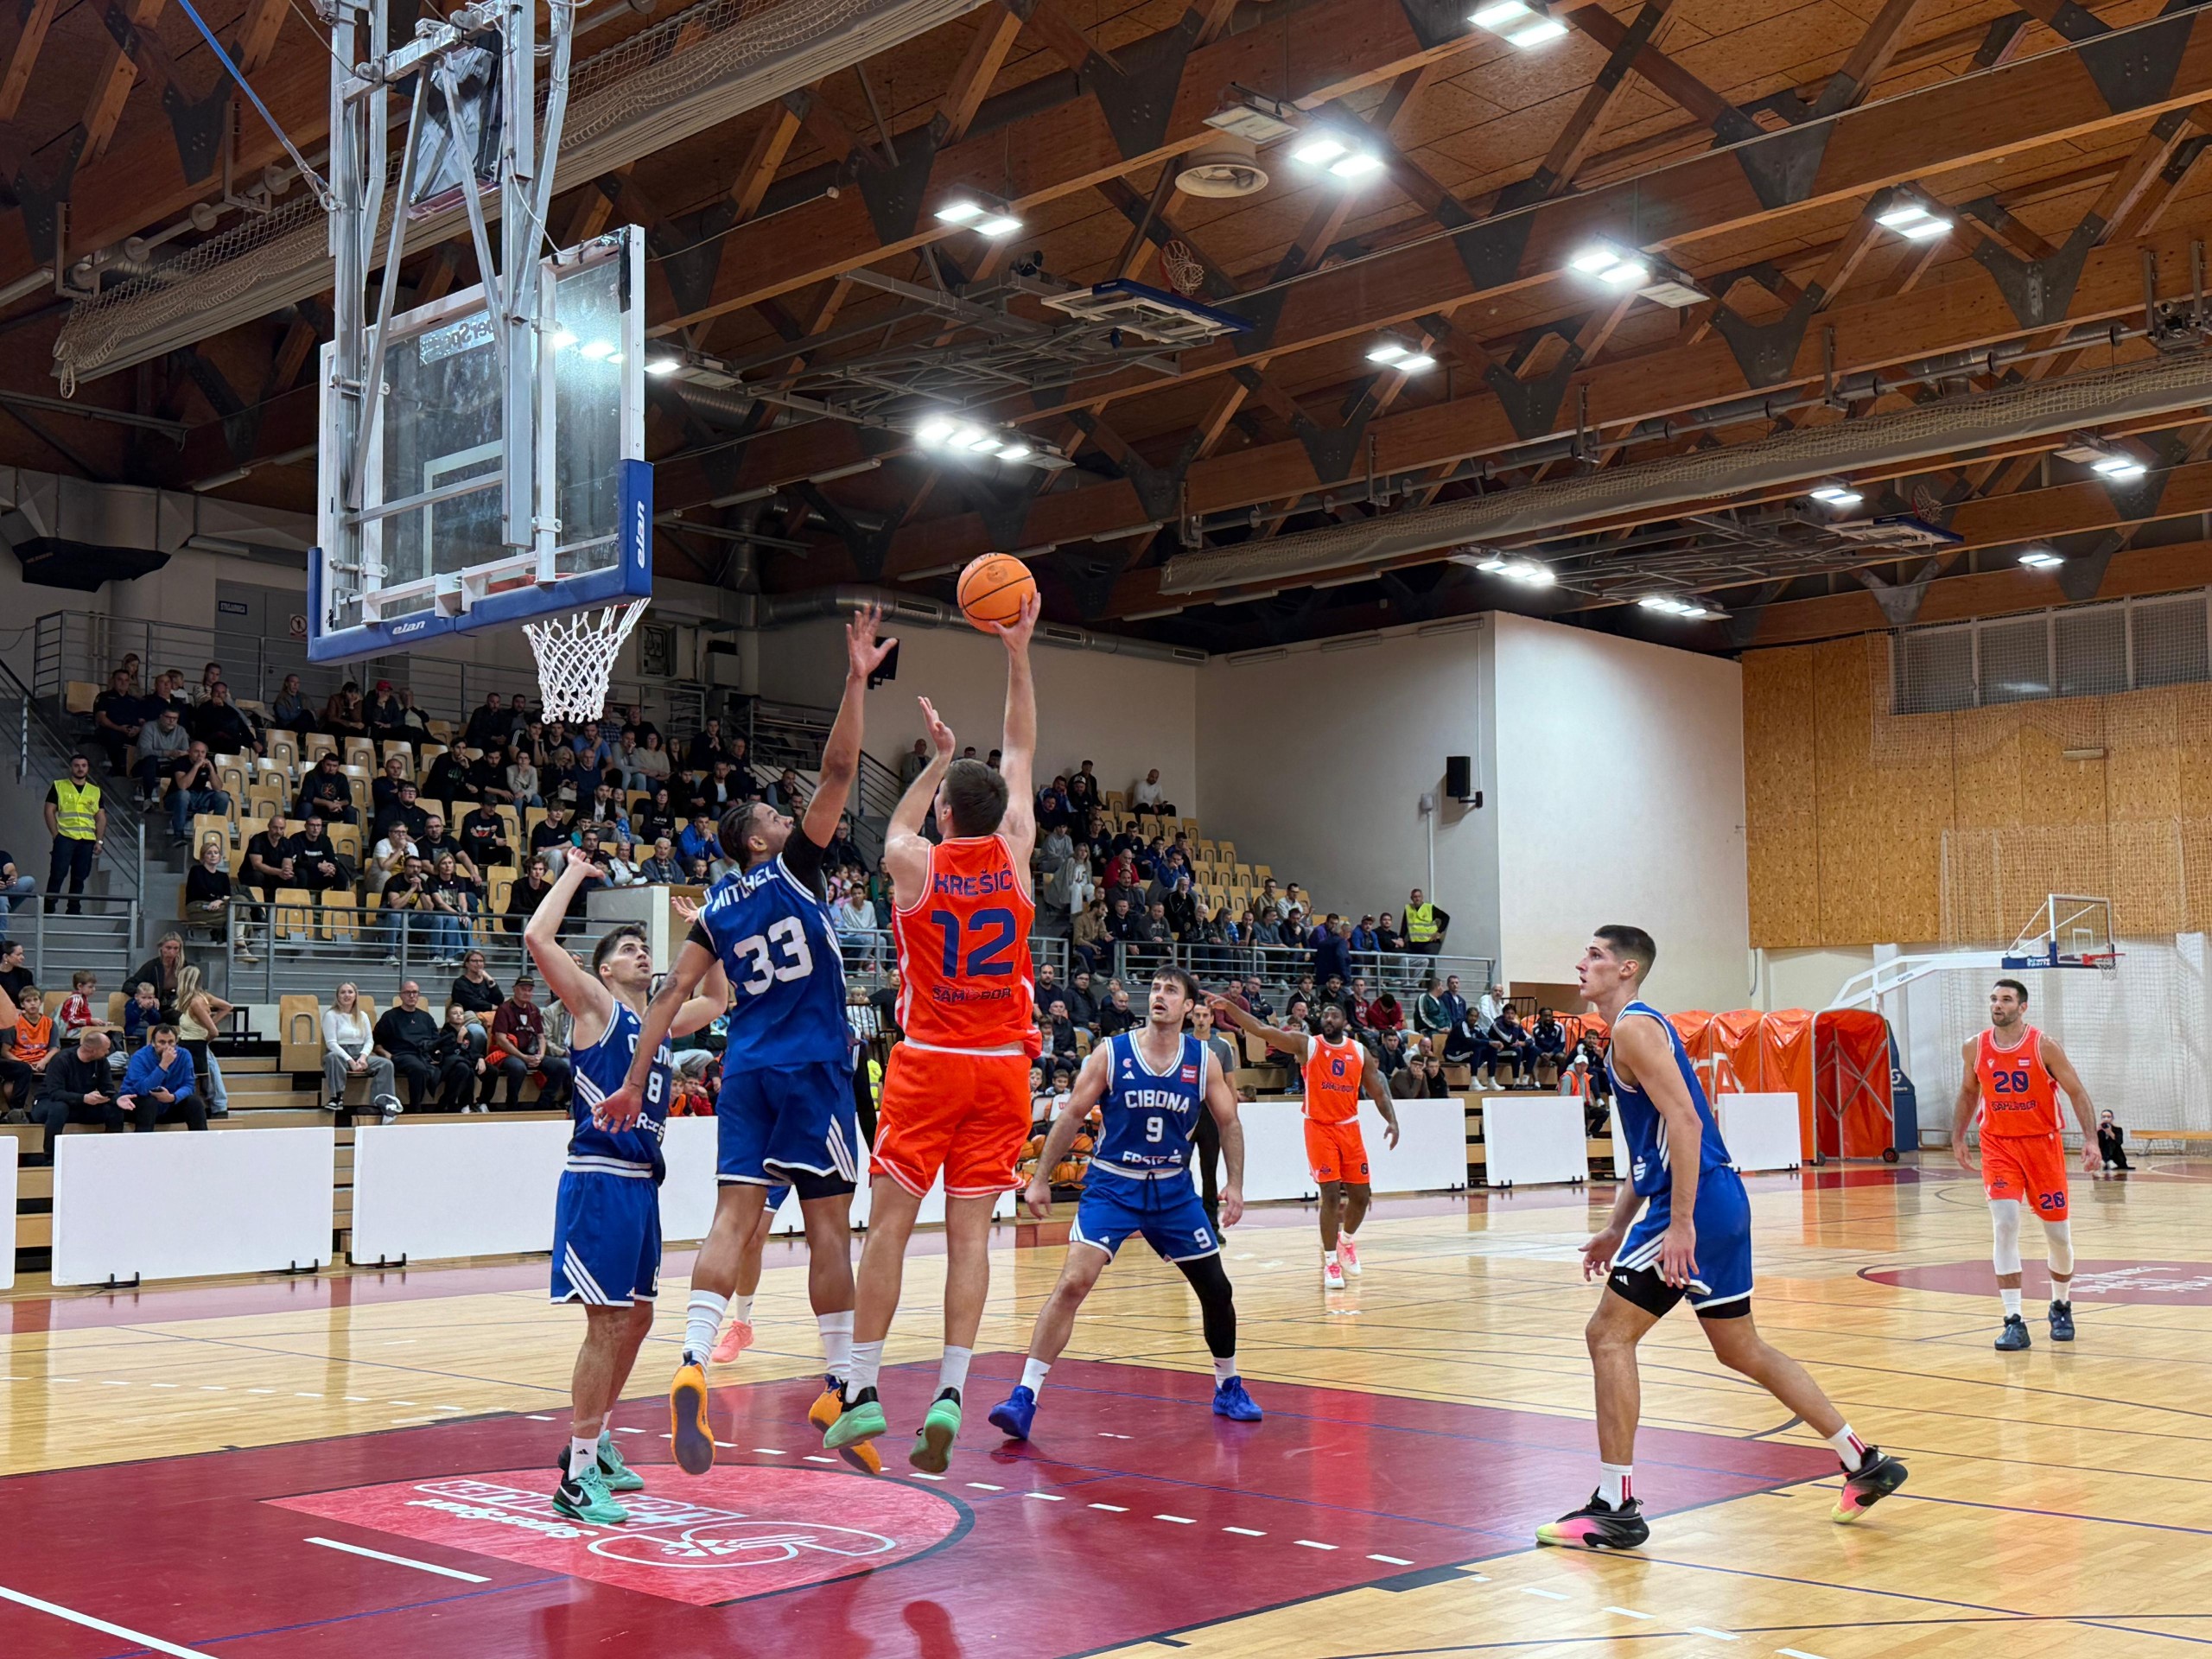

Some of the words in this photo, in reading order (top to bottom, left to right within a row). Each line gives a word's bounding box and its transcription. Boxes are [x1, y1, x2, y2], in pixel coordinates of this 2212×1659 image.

[392, 620, 426, 635] elan
[933, 863, 1013, 896] KREŠIĆ
[931, 907, 1016, 978] 12
[734, 916, 813, 995] 33
[1332, 1058, 1345, 1077] 0
[647, 1071, 664, 1103] 8
[1993, 1071, 2029, 1093] 20
[1124, 1090, 1190, 1114] CIBONA
[1146, 1116, 1164, 1142] 9
[2039, 1191, 2065, 1210] 20
[1193, 1227, 1211, 1249] 9
